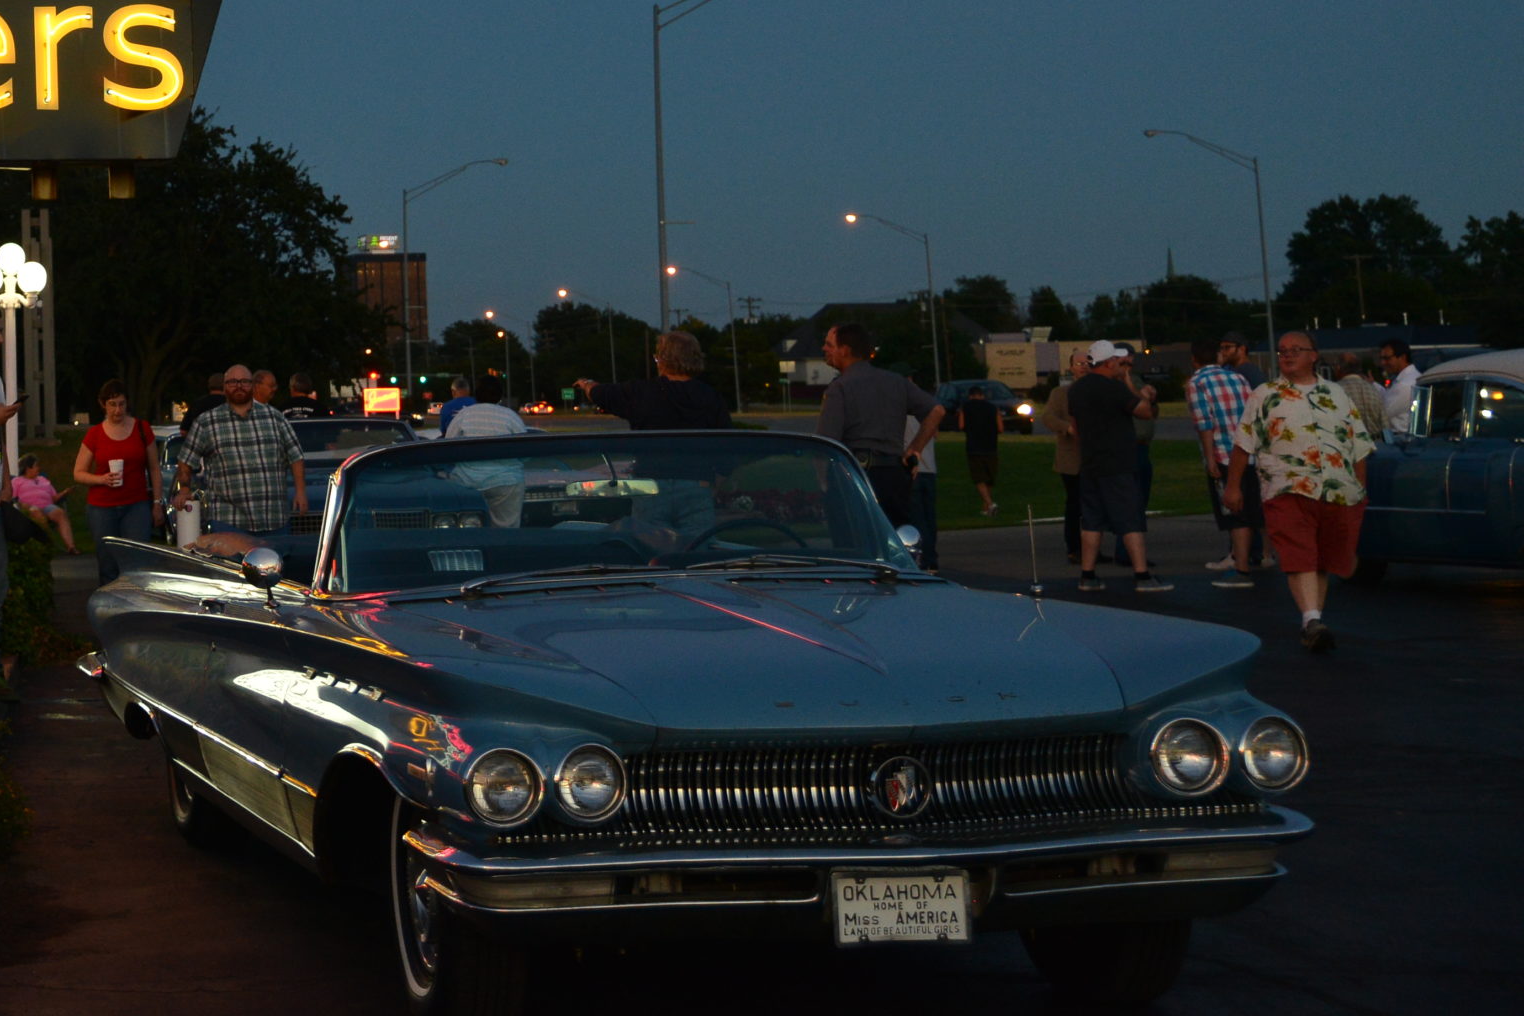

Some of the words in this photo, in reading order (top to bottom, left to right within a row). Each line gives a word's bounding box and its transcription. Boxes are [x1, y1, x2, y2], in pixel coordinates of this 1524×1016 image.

[843, 884, 956, 901] OKLAHOMA
[873, 902, 903, 910] HOME
[916, 901, 927, 910] OF
[896, 911, 958, 924] AMERICA
[844, 927, 868, 936] LAND
[870, 927, 881, 935] OF
[883, 925, 932, 935] BEAUTIFUL
[934, 924, 960, 934] GIRLS
